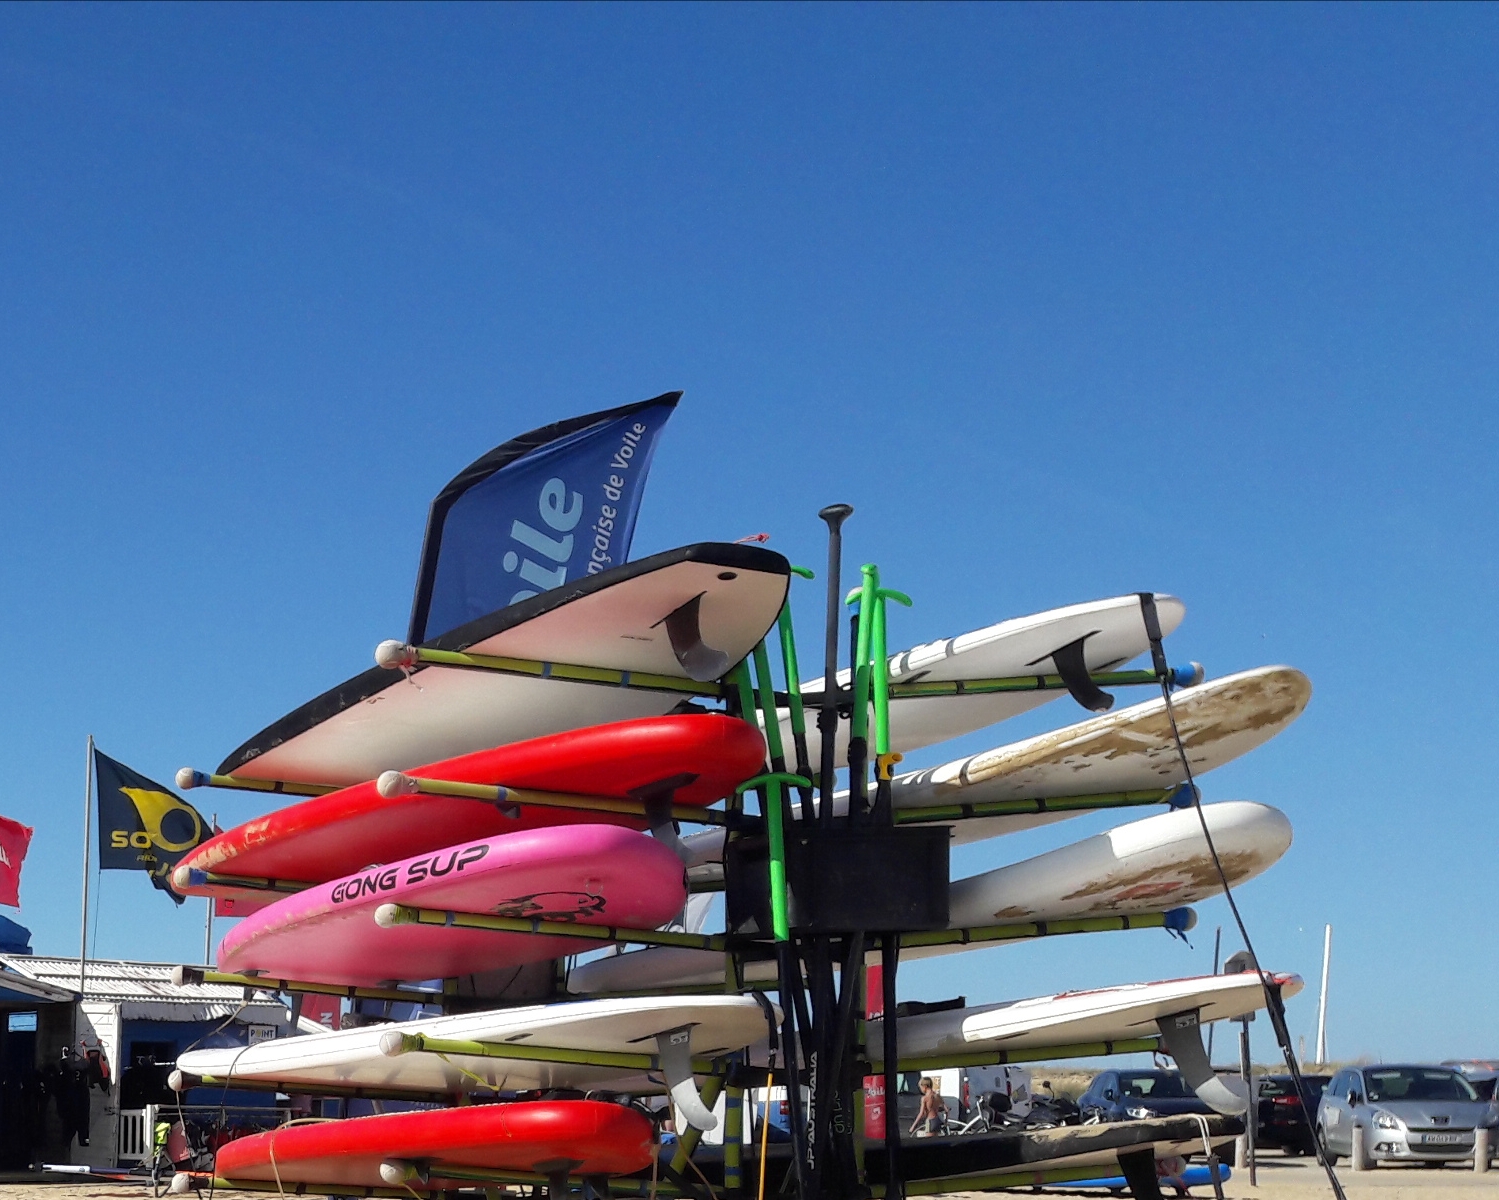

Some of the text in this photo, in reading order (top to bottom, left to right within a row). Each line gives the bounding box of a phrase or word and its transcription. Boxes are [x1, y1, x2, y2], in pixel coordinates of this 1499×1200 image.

[610, 422, 647, 470] Voile
[603, 474, 624, 501] de
[331, 844, 490, 904] GONG SUP
[250, 1028, 274, 1039] POINT
[806, 1051, 817, 1170] JP-AUSTRALIA
